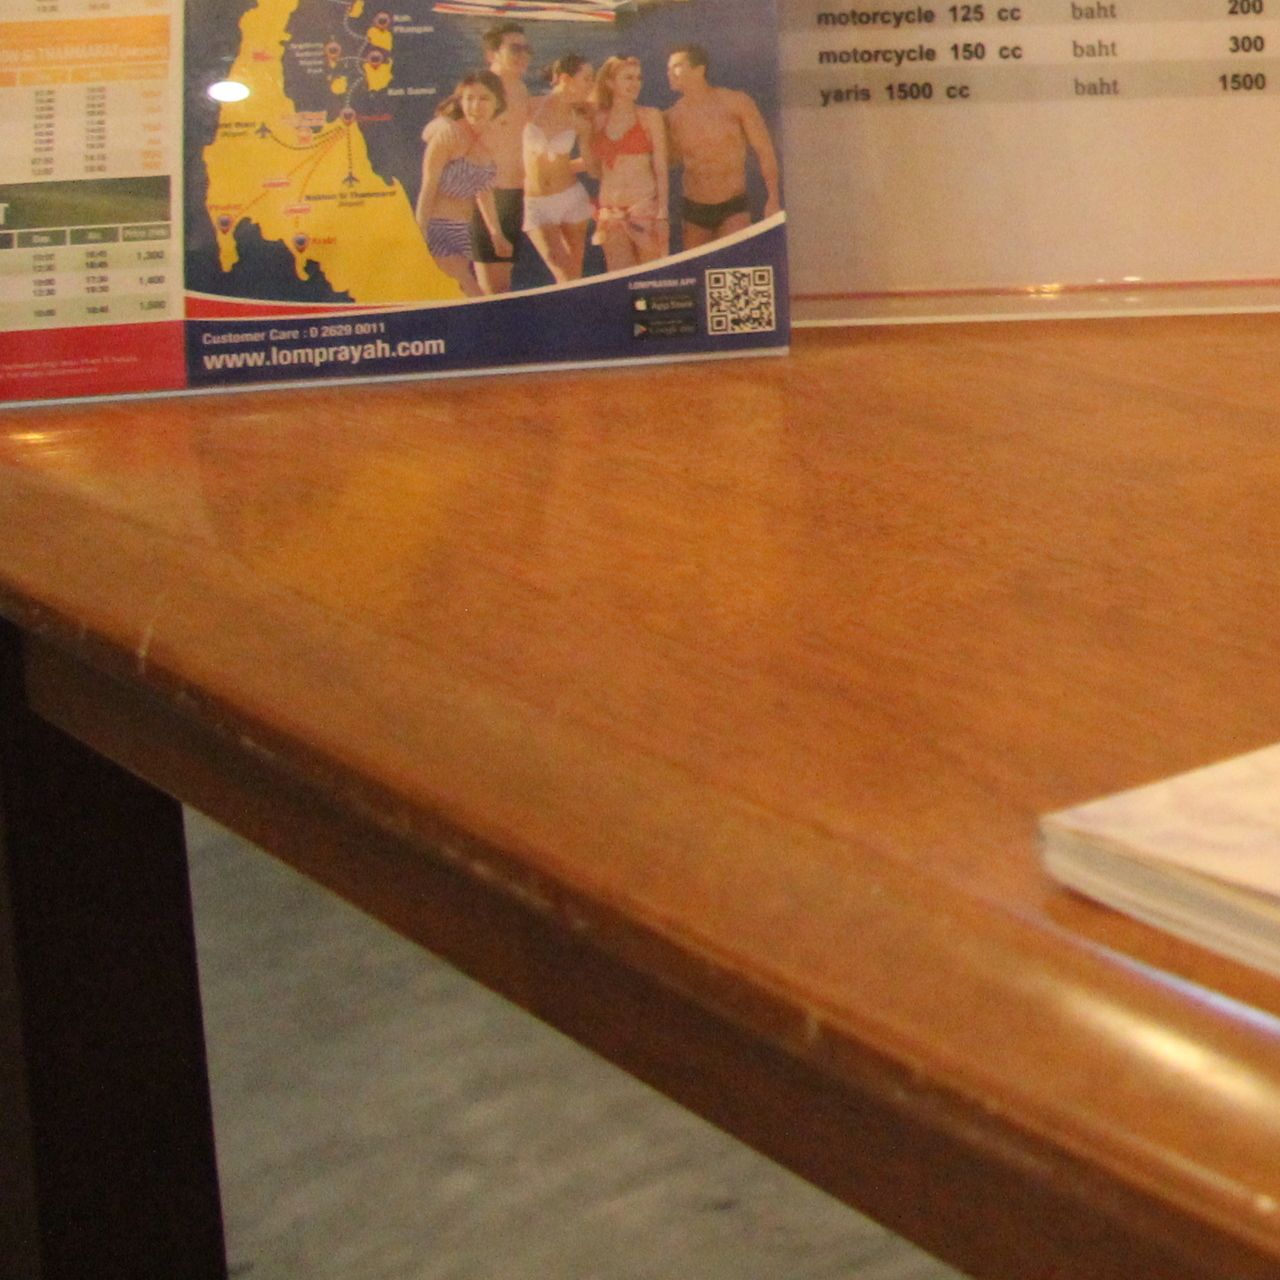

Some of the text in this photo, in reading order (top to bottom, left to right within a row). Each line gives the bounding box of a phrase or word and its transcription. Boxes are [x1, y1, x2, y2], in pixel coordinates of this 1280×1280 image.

[817, 6, 936, 28] motorcycle
[949, 4, 985, 22] 125
[997, 7, 1021, 22] cc
[1071, 2, 1116, 20] baht
[819, 35, 1265, 66] motorcycle 150 cc baht 300
[821, 73, 1266, 107] yaris 1500 cc baht 1500
[203, 329, 265, 345] Customer
[269, 328, 299, 341] Care
[321, 324, 353, 338] 2629
[355, 322, 386, 335] 0011
[203, 338, 446, 370] www.lomprayah.com
